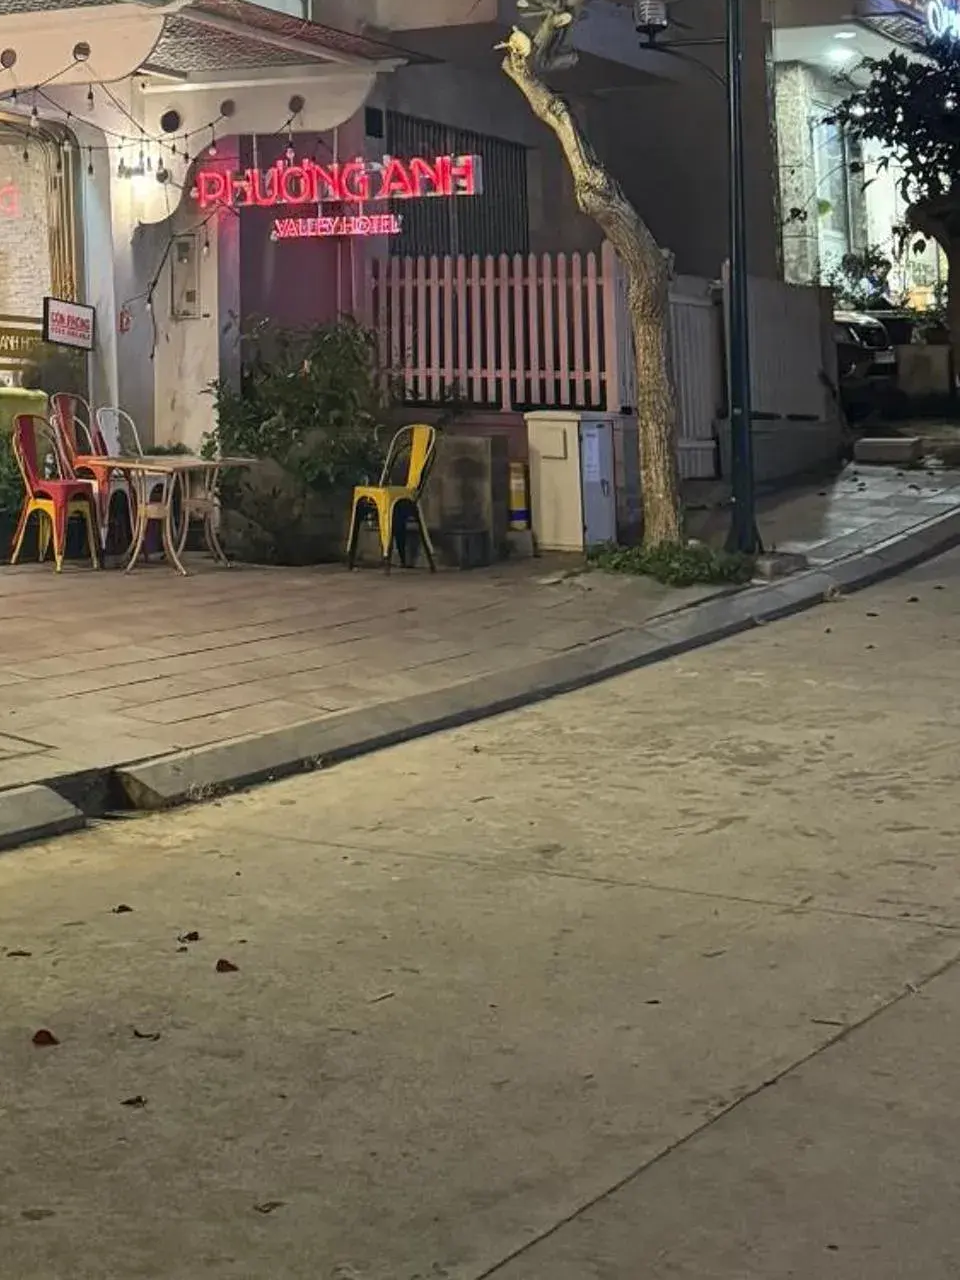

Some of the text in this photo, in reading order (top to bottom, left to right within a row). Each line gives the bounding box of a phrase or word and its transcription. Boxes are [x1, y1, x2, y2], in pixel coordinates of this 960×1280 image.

[381, 154, 475, 197] ANH
[275, 213, 402, 238] VALLEY HOTEL
